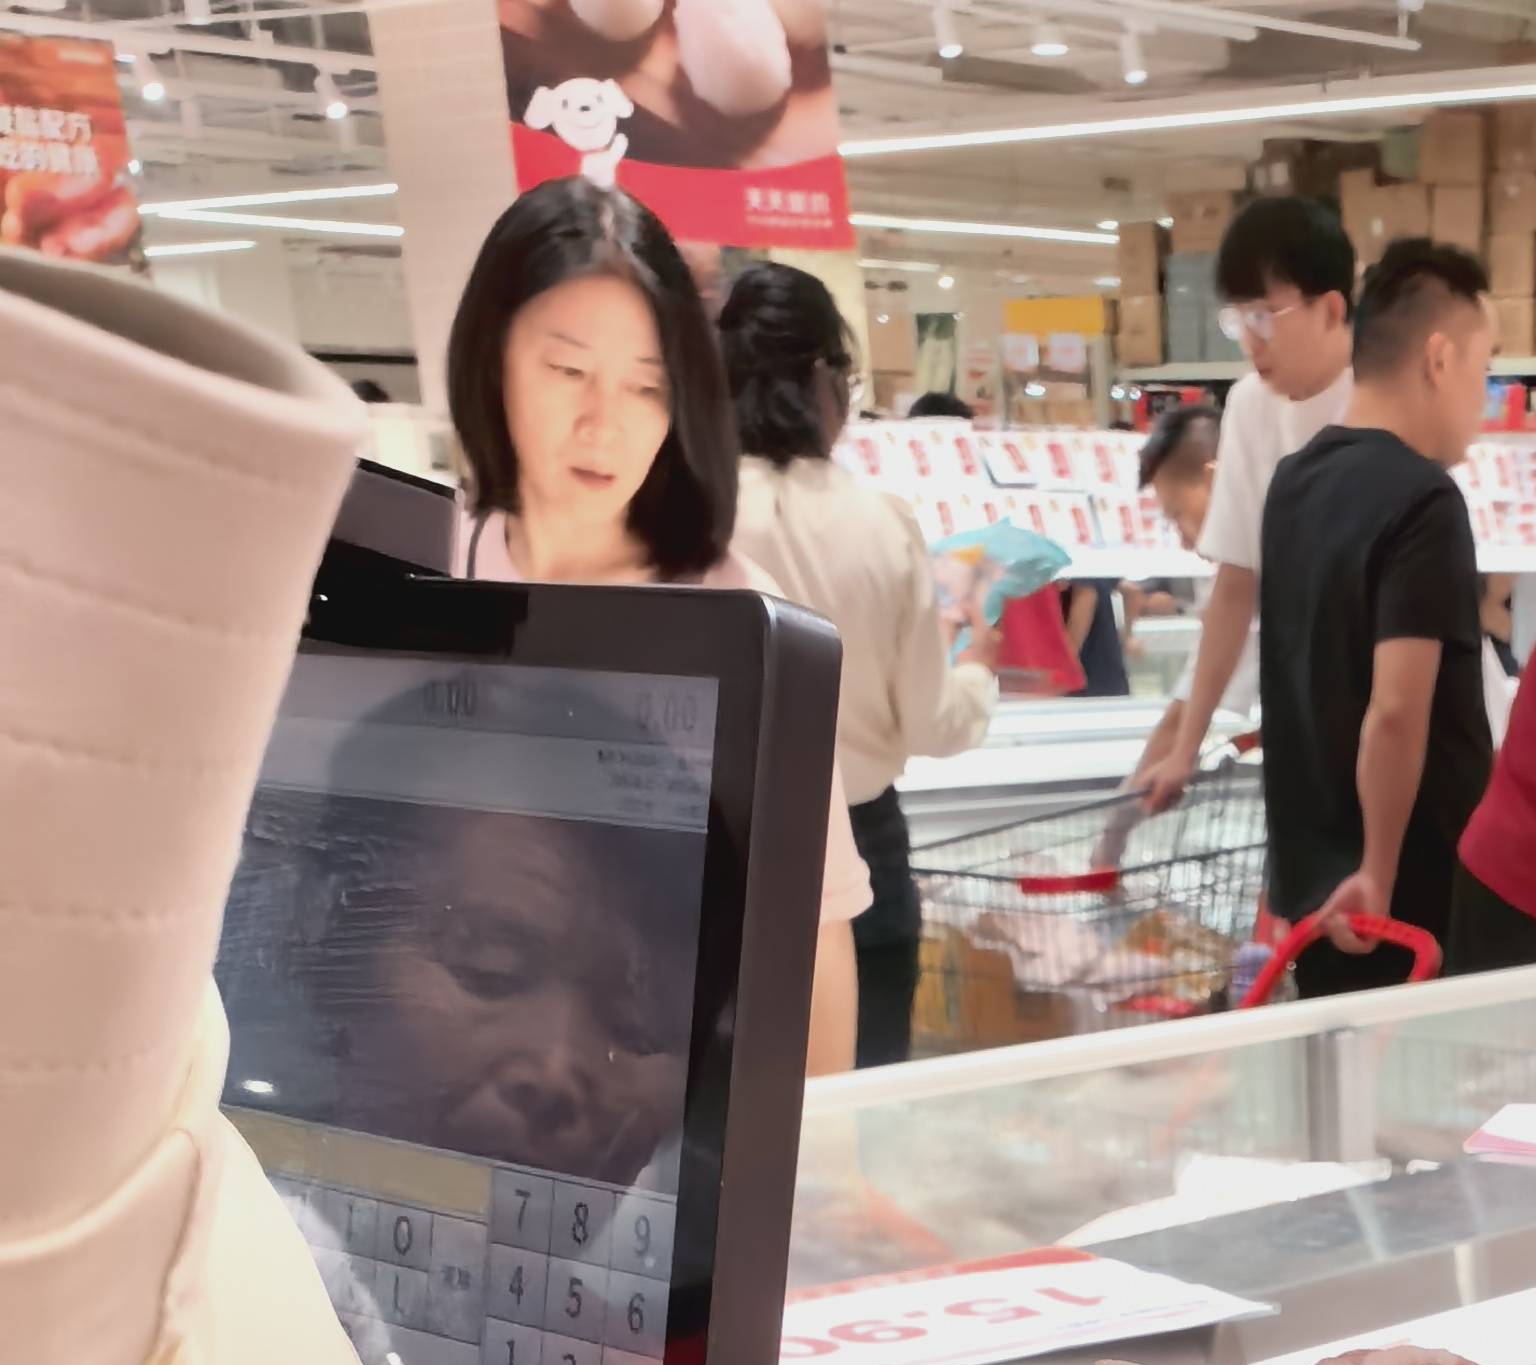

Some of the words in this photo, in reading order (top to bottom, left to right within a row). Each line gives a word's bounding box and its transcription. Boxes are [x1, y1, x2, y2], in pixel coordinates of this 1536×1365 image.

[515, 1188, 531, 1232] 7
[571, 1202, 589, 1245] 8
[634, 1214, 651, 1257] 9
[508, 1265, 524, 1306] 4
[565, 1277, 583, 1318] 5
[627, 1292, 645, 1334] 6
